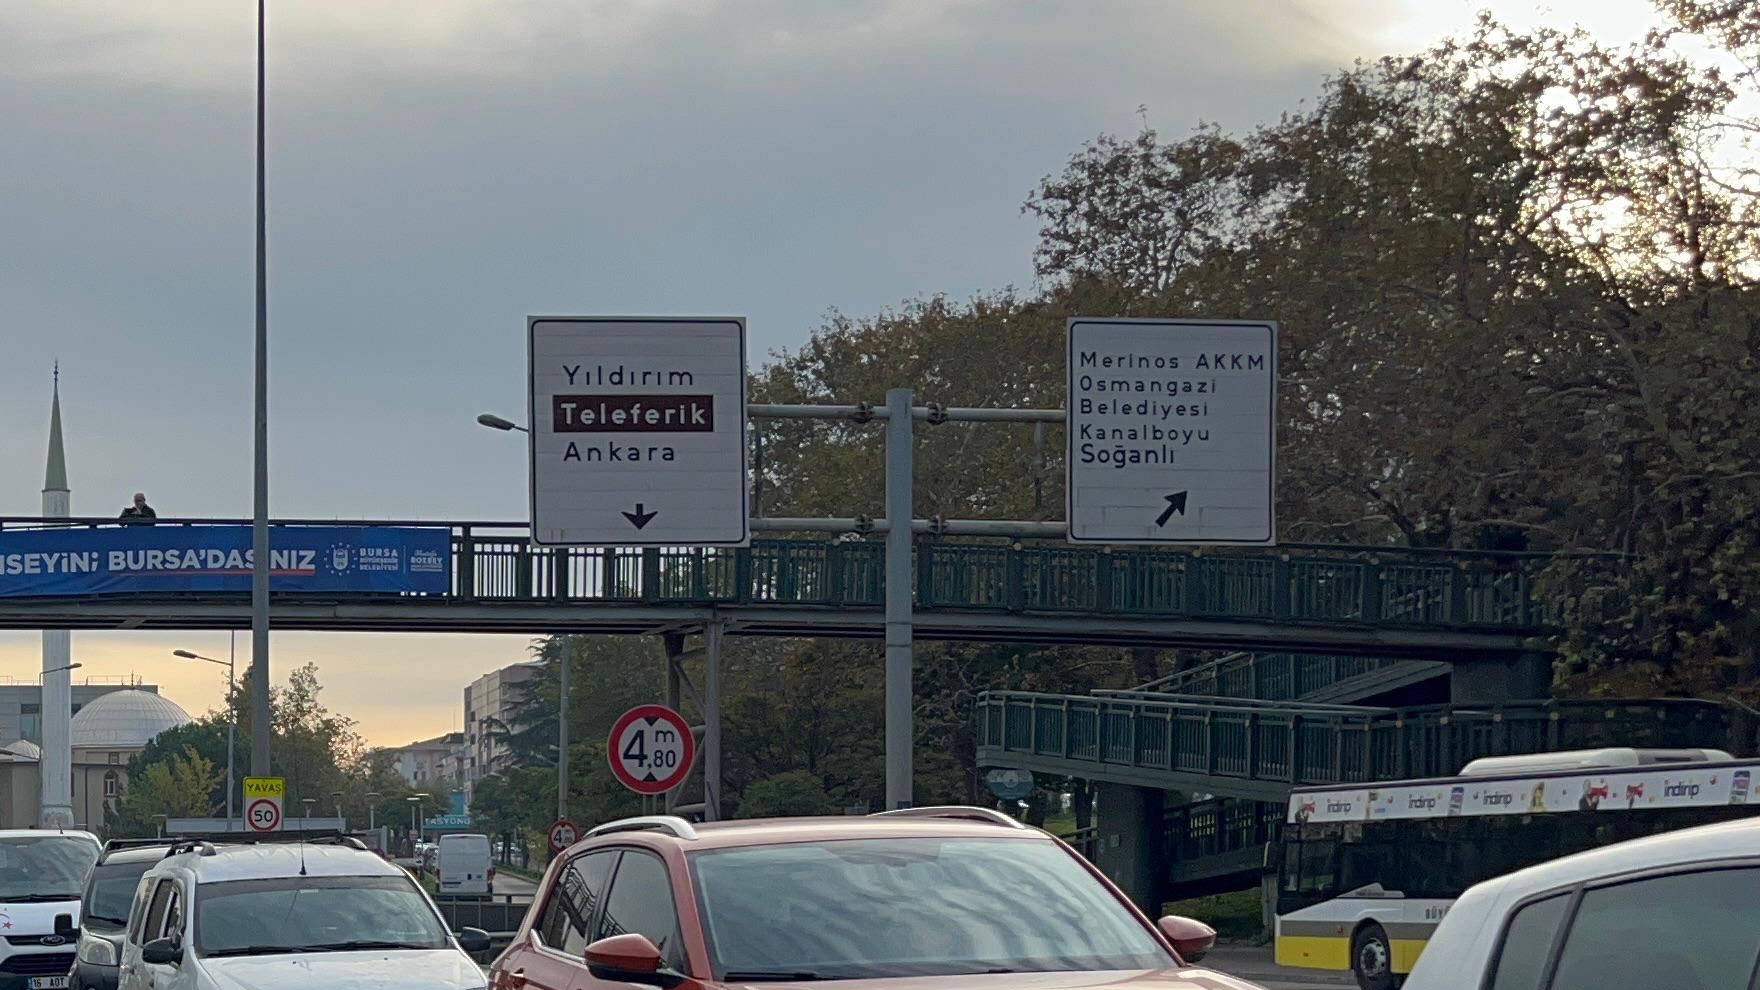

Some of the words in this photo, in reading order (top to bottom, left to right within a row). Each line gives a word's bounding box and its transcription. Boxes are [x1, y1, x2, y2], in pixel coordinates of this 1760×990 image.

[1080, 351, 1179, 369] Merinos
[1196, 353, 1264, 370] AKKM
[563, 365, 693, 385] Yıldırım
[1080, 375, 1216, 396] Osmangazi
[561, 403, 705, 424] Teleferik
[1080, 399, 1208, 420] Belediyesi
[1080, 424, 1209, 445] Kanalboyu
[563, 441, 675, 461] Ankara
[1081, 443, 1174, 468] Soğanlı
[108, 549, 316, 571] BURSA'DASNIZ
[360, 548, 398, 557] BURSA
[254, 810, 274, 823] 50
